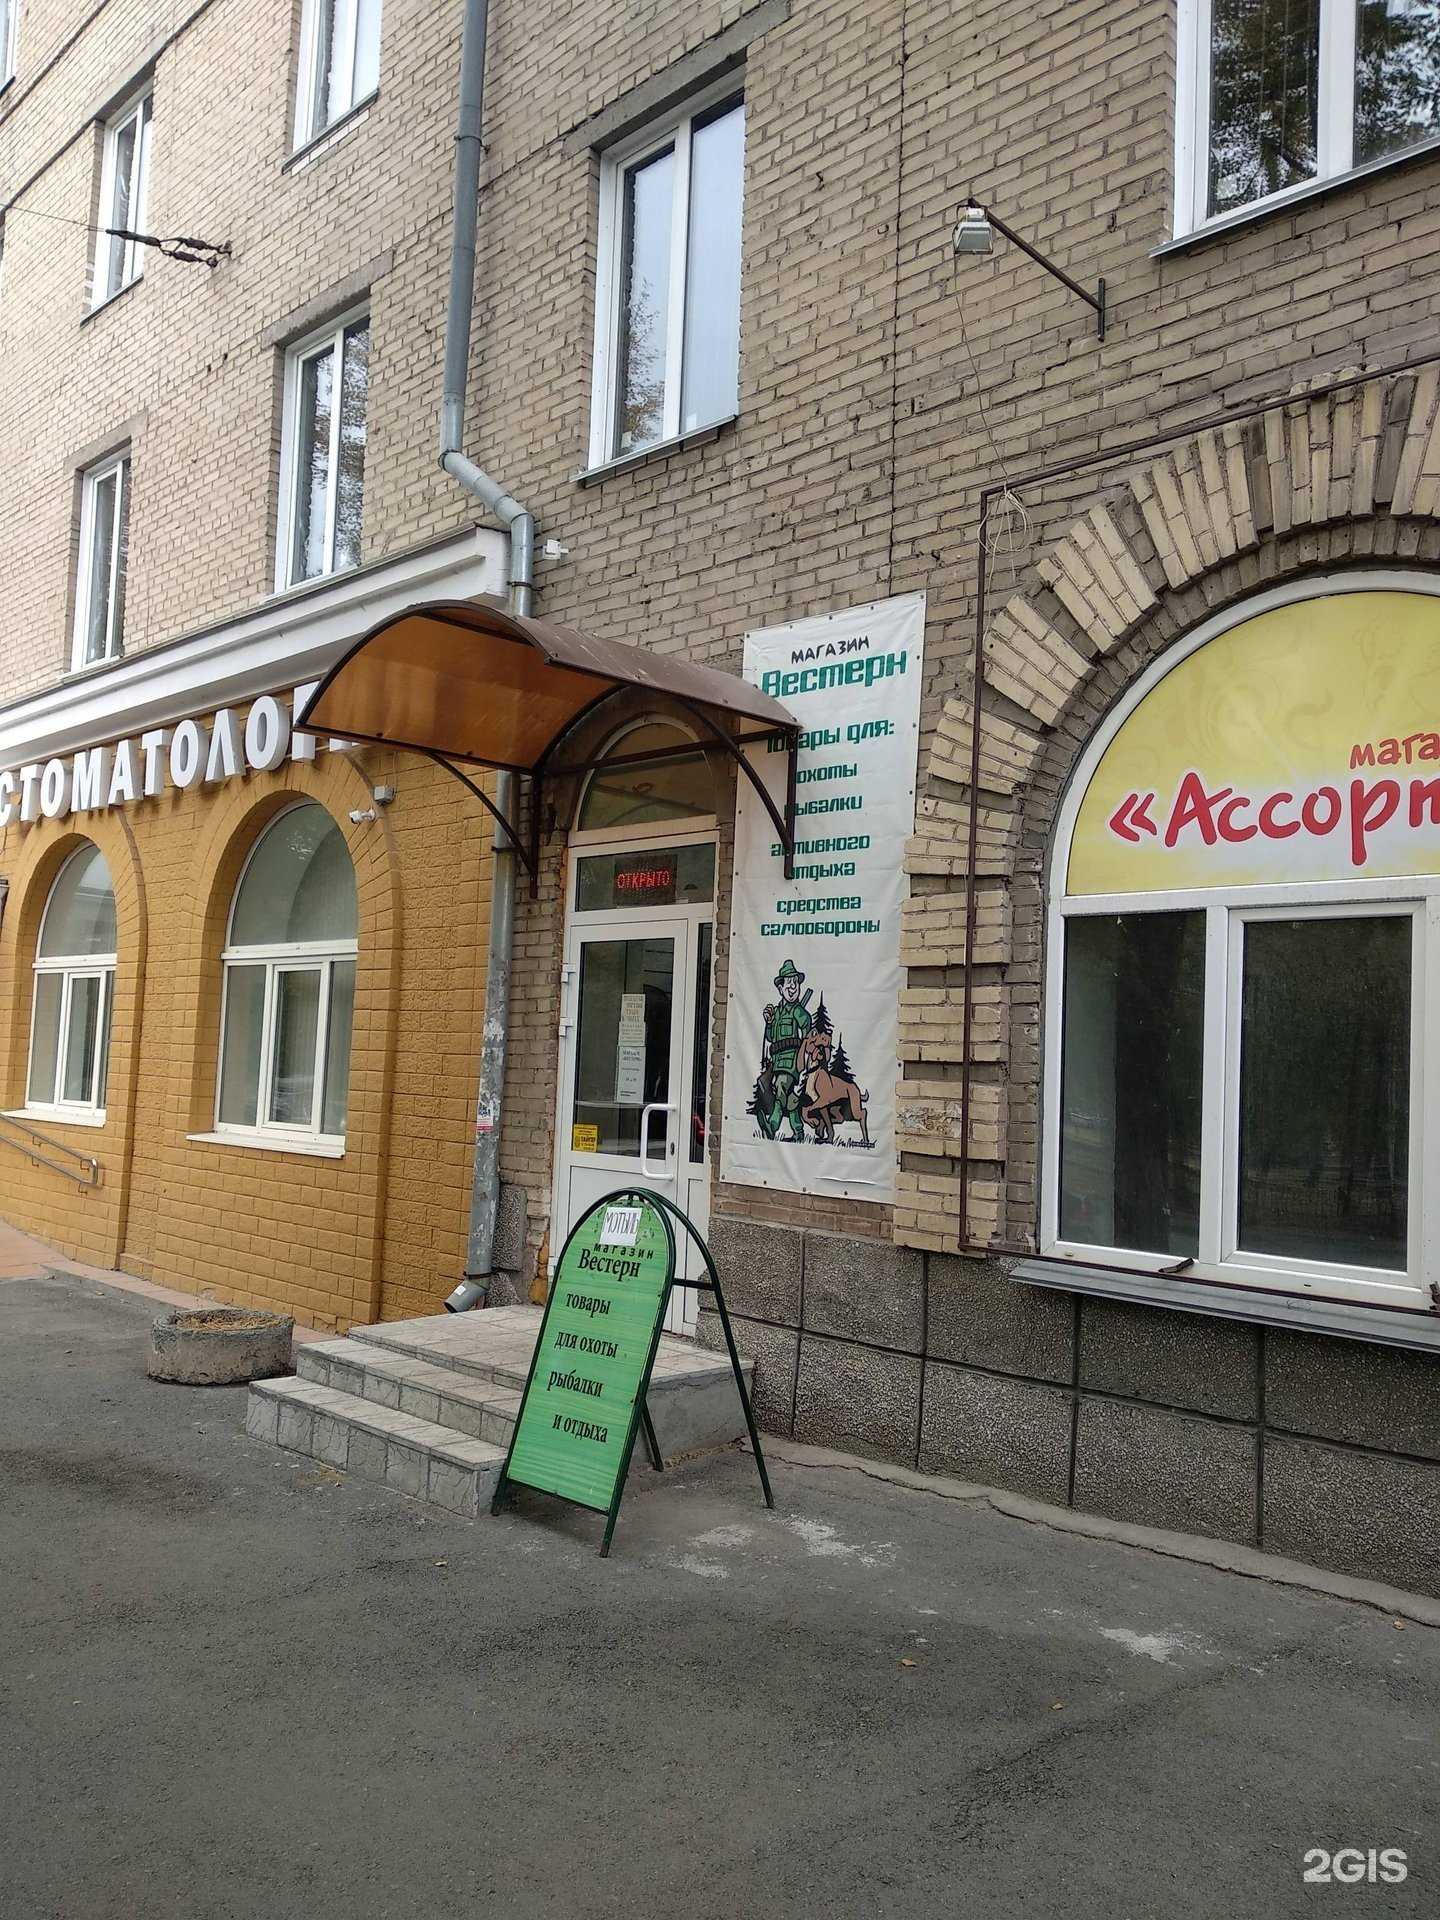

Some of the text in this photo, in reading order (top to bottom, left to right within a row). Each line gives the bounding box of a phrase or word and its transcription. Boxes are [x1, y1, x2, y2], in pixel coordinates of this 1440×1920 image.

[791, 635, 869, 664] МАГАЗИН
[761, 649, 907, 698] Вестерн
[847, 719, 894, 745] для:
[0, 681, 360, 826] СТОМАТОЛОГ
[796, 763, 857, 784] охоты
[784, 796, 863, 821] ыбалки
[617, 870, 670, 889] ОТКРЫТО
[791, 862, 856, 882] тдыха
[776, 896, 861, 916] средства
[760, 919, 881, 938] самообороны
[593, 1243, 654, 1259] магазин
[577, 1248, 641, 1282] Вестерн
[566, 1291, 611, 1318] товары
[554, 1332, 618, 1359] для охоты
[547, 1370, 603, 1398] рыбалки
[552, 1414, 608, 1444] и отдыха
